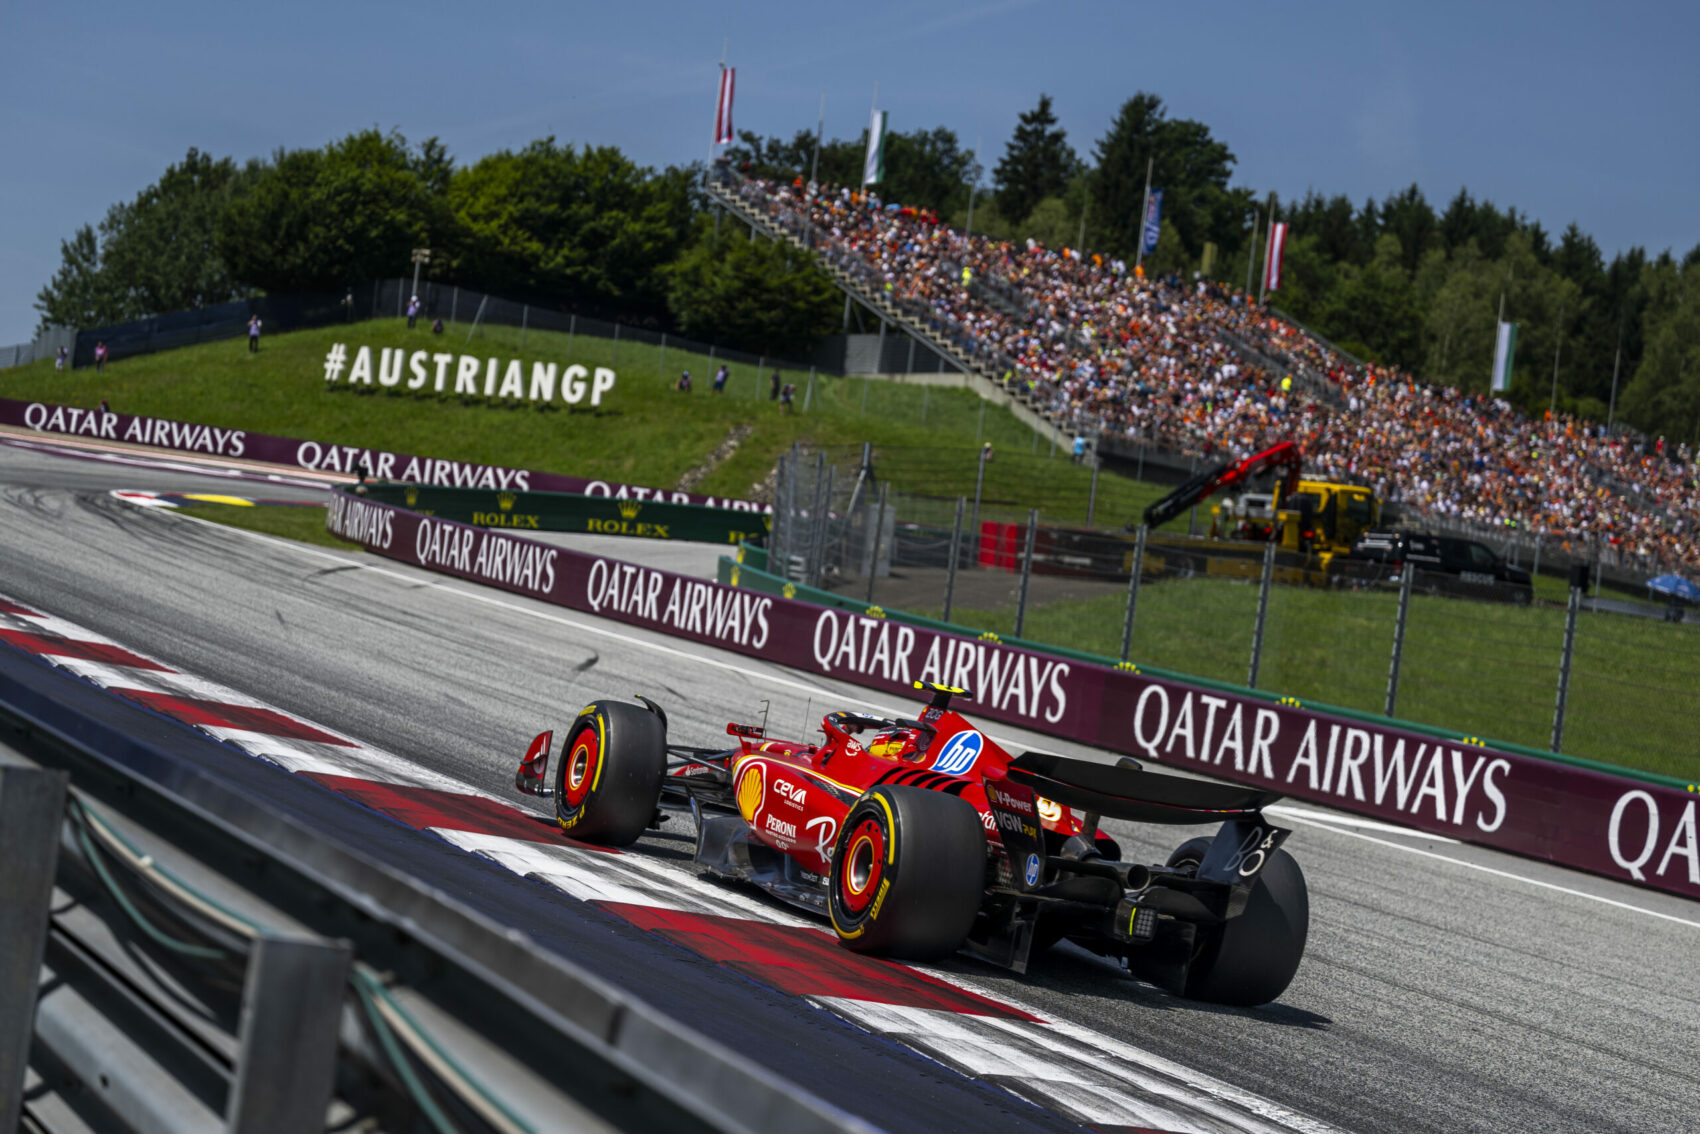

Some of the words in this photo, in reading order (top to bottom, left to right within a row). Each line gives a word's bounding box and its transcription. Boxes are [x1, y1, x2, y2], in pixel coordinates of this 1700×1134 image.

[324, 343, 616, 406] #AUSTRIANGP
[24, 403, 118, 439] QATAR
[124, 416, 246, 457] AIRWAYS
[297, 441, 395, 479] QATAR
[402, 456, 530, 491] AIRWAYS
[341, 499, 395, 550] AIRWAYS
[472, 511, 540, 529] ROLEX
[587, 518, 670, 539] ROLEX
[416, 518, 473, 573] QATAR
[474, 536, 558, 594] AIRWAYS
[587, 558, 664, 621] QATAR
[663, 578, 772, 650] AIRWAYS
[813, 609, 916, 686] QATAR
[919, 635, 1070, 724] AIRWAYS
[847, 739, 862, 752] aws
[935, 731, 978, 772] hp
[1133, 684, 1280, 780] QATAR
[1286, 718, 1512, 834] AIRWAYS
[765, 813, 797, 838] PERONI
[994, 809, 1023, 833] VGW
[995, 790, 1032, 813] V-Power
